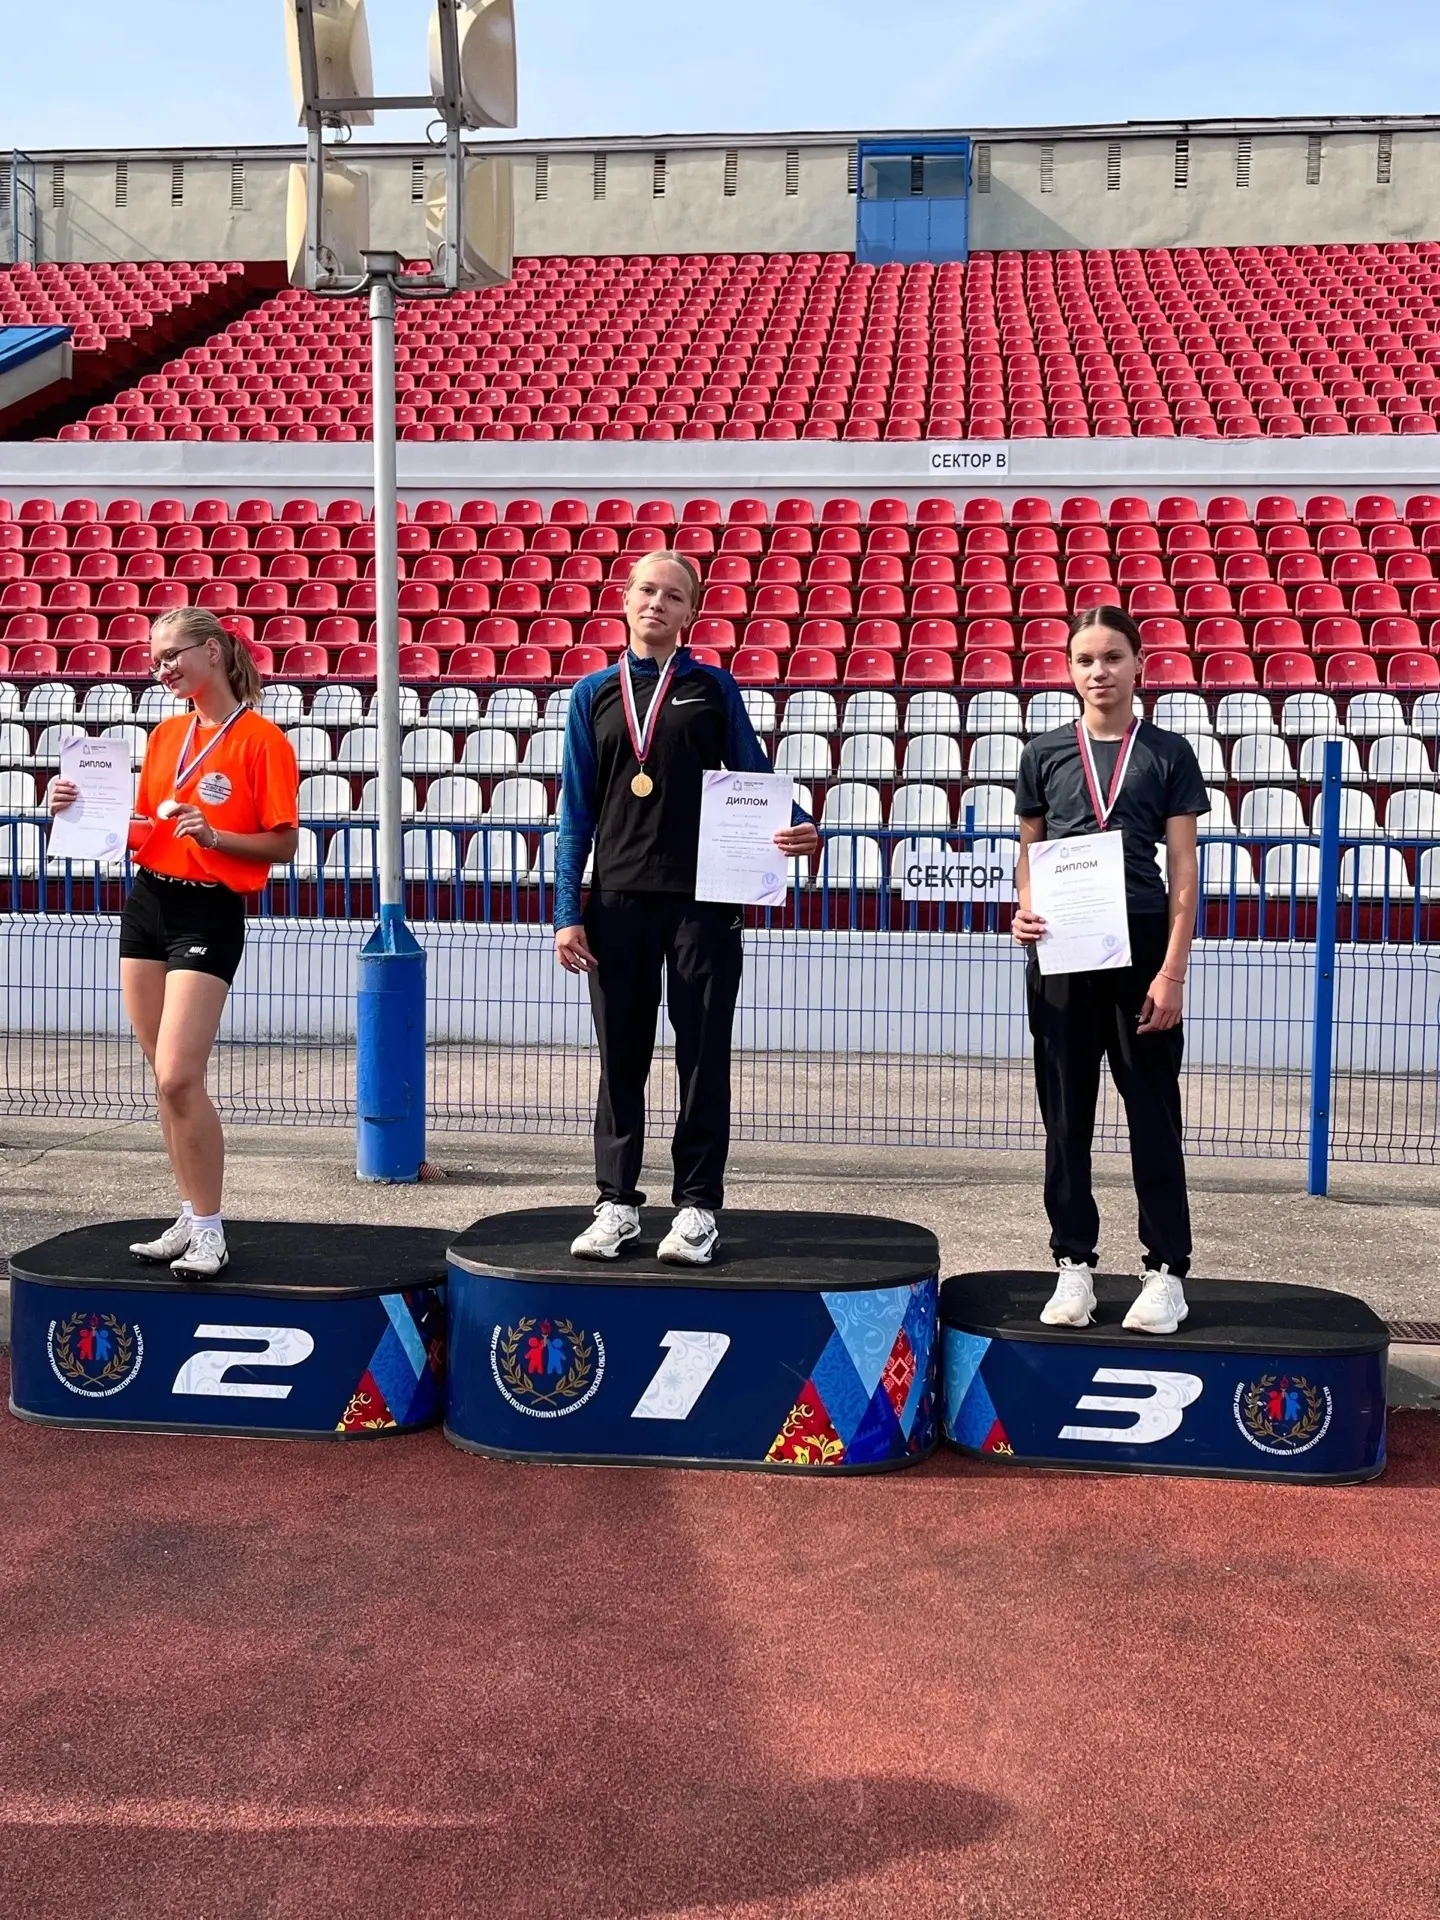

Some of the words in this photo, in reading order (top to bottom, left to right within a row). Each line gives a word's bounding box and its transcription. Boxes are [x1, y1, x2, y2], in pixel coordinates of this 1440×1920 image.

[931, 453, 992, 468] СЕКТОР
[996, 453, 1006, 468] В
[79, 759, 112, 769] ДИПЛОМ
[725, 796, 769, 806] ДИПЛОМ
[907, 864, 1004, 888] СЕКТОР
[1054, 860, 1099, 874] ДИПЛОМ
[188, 946, 208, 956] NIKE
[491, 1325, 502, 1352] ЦЕНТР
[593, 1331, 605, 1368] ОБЛАСТИ
[171, 1323, 315, 1399] 2
[490, 1350, 512, 1401] СПОРТИВНОЙ
[630, 1330, 731, 1420] 1
[557, 1368, 604, 1417] НИЖЕГОРОДСКОЙ
[509, 1397, 557, 1418] ПОДГОТОВКИ
[1057, 1367, 1204, 1444] 3
